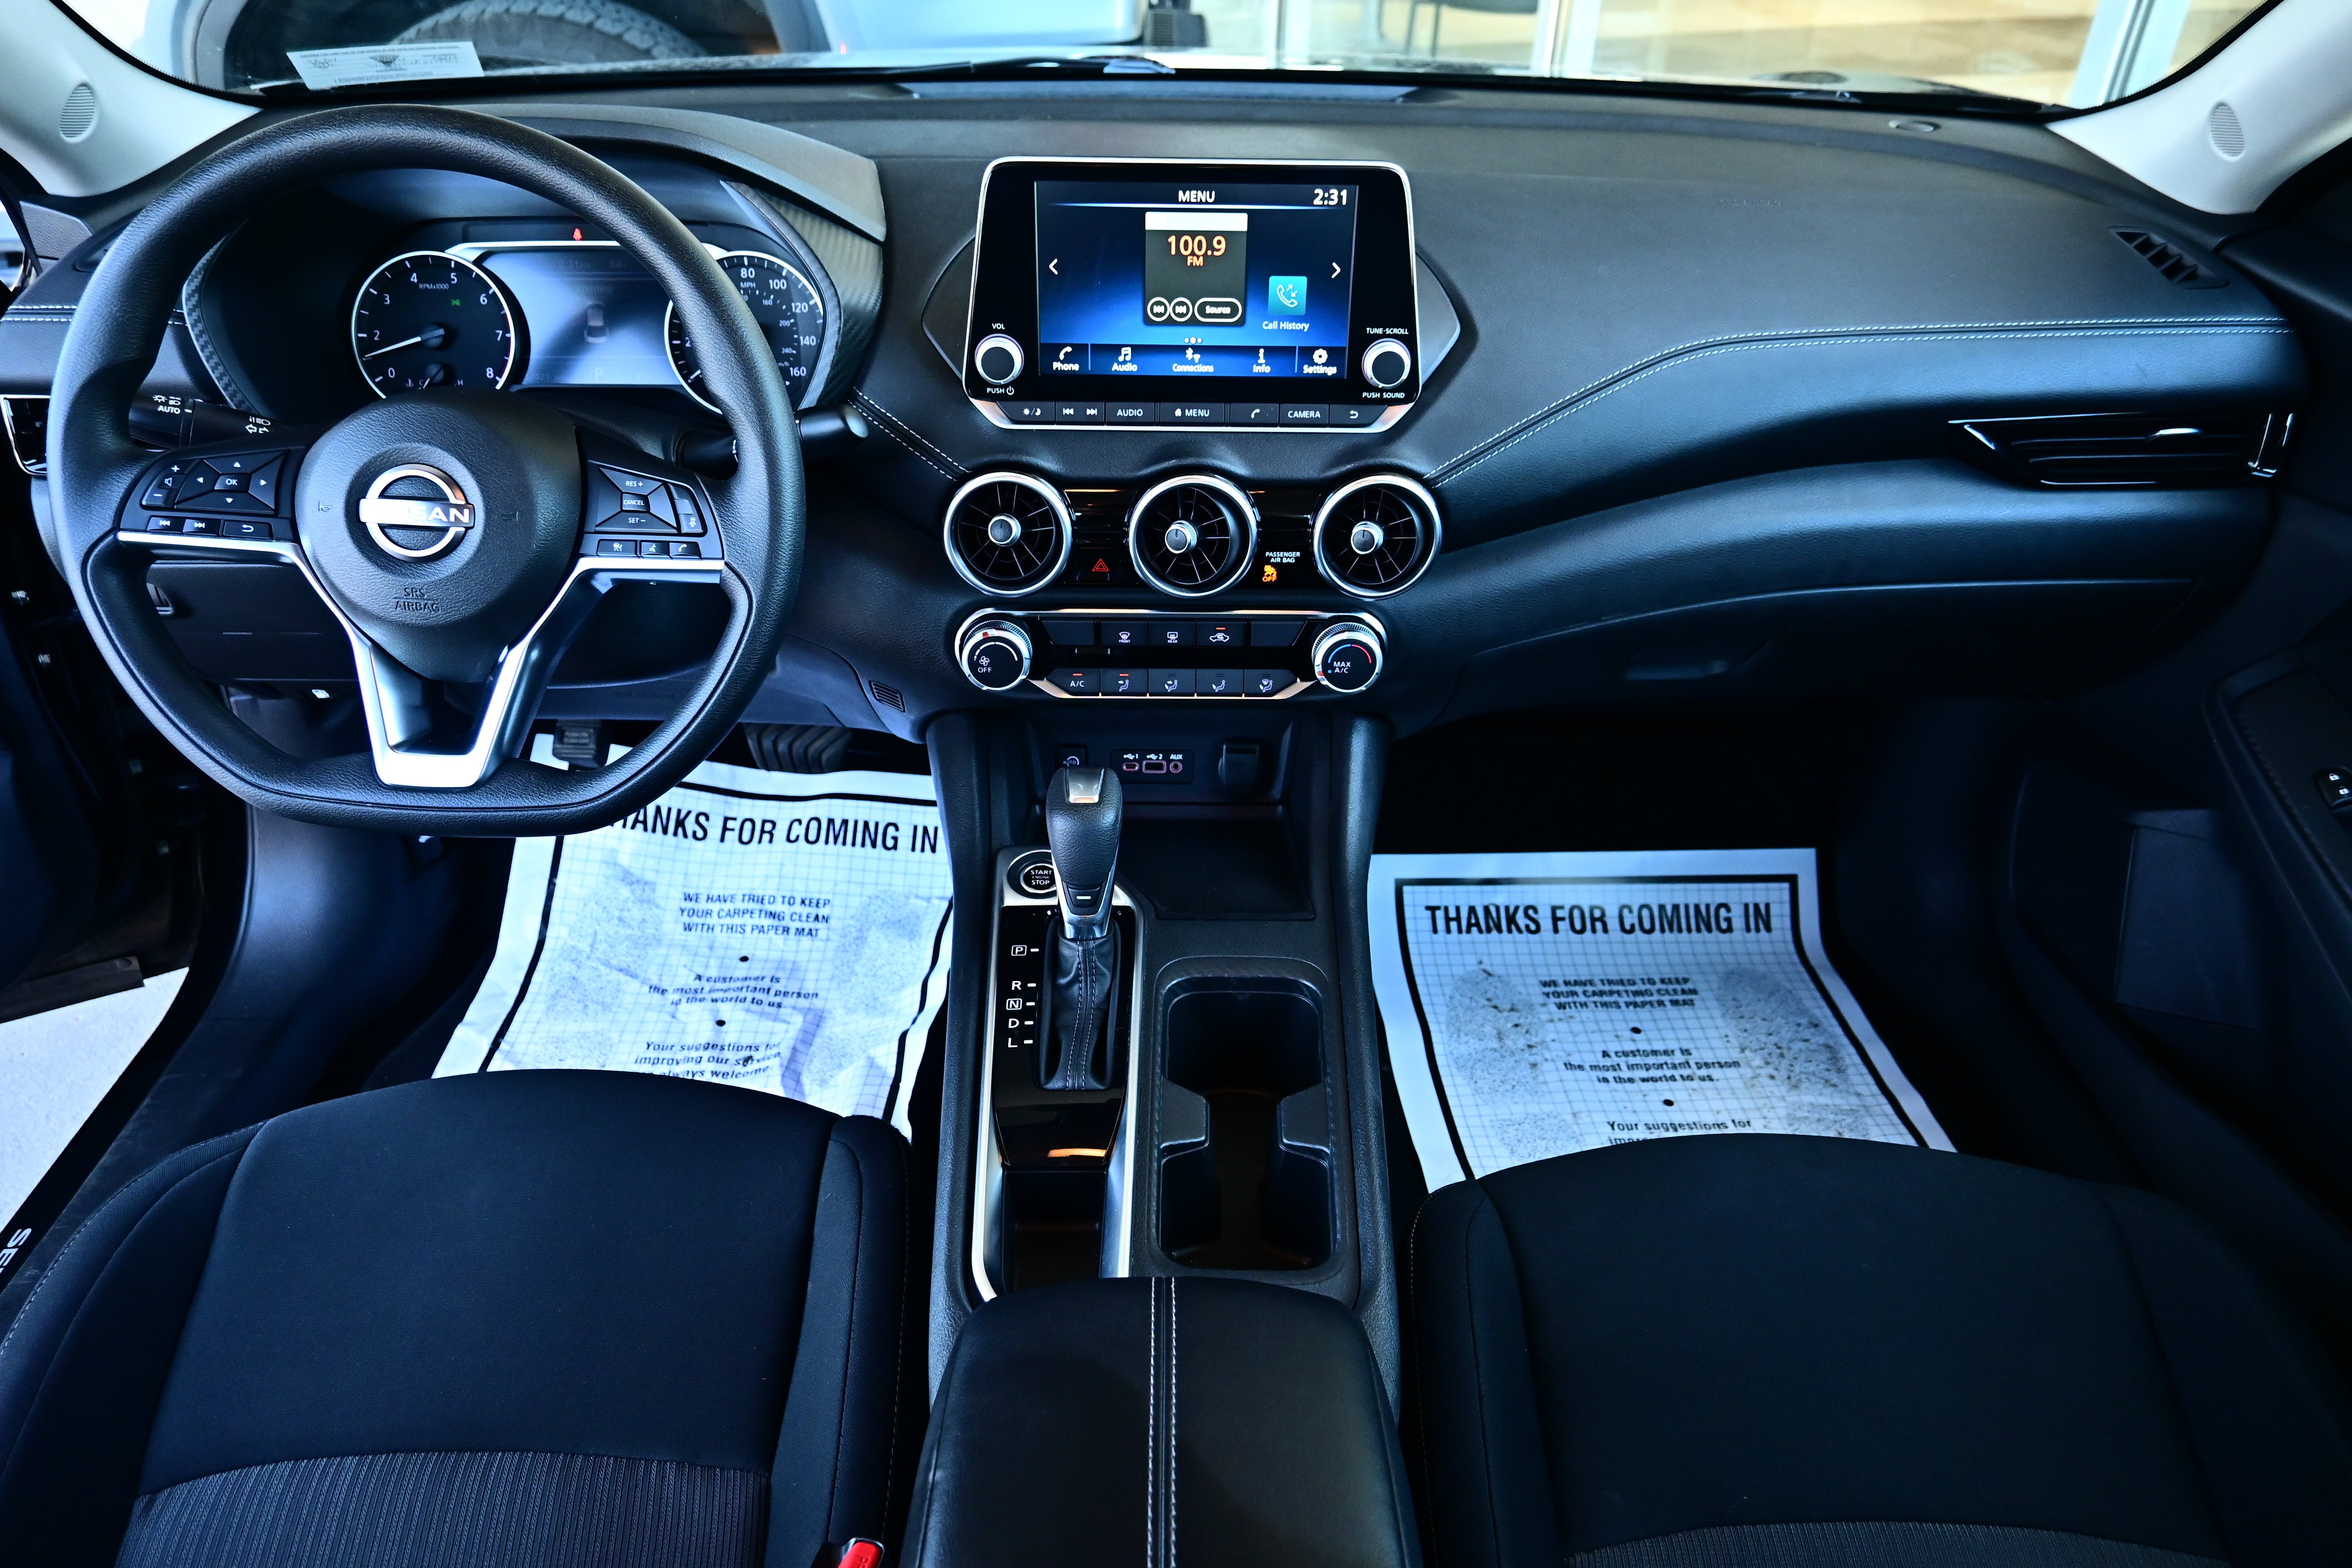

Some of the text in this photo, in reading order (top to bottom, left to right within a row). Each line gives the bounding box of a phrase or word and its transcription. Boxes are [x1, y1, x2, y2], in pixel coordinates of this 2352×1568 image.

[1178, 190, 1215, 203] MENU
[1312, 188, 1347, 205] 2:31
[1168, 235, 1226, 256] 100.9
[1187, 256, 1203, 267] FM
[410, 272, 418, 283] 4
[450, 272, 457, 284] 5
[740, 268, 755, 278] 80
[769, 279, 787, 289] 100
[383, 294, 390, 305] 3
[480, 294, 487, 305] 6
[791, 302, 808, 313] 120
[1205, 305, 1231, 314] Source
[1262, 321, 1310, 332] Call History
[373, 331, 380, 340] 2
[495, 331, 503, 340] 7
[799, 336, 816, 346] 140
[789, 367, 806, 377] 160
[1053, 362, 1079, 371] Phone
[1111, 362, 1138, 372] Audio
[1172, 363, 1214, 373] Connections
[1252, 364, 1271, 374] Info
[1303, 365, 1337, 376] Settings
[388, 368, 395, 378] 0
[486, 367, 493, 378] 8
[158, 406, 180, 414] AUTO
[1116, 408, 1143, 417] AUDIO
[1185, 408, 1210, 417] MENU
[1288, 410, 1320, 419] CAMERA
[404, 588, 426, 597] SRS
[395, 600, 440, 612] AIRBAG
[610, 805, 938, 853] ANKS FOR COMING IN
[683, 892, 830, 909] WE HAVE TRIED TO KEEP
[679, 907, 830, 924] YOUR CARPETING CLEAN
[1425, 903, 1773, 935] THANKS FOR COMING IN
[683, 922, 820, 937] WITH THIS PAPER MAT
[693, 975, 702, 983] A
[770, 975, 781, 984] is
[1012, 980, 1021, 990] R
[1640, 977, 1656, 985] TO
[648, 985, 667, 995] the
[774, 989, 819, 999] person
[711, 995, 746, 1004] world
[751, 997, 763, 1006] to
[1009, 1000, 1018, 1008] N
[1008, 1018, 1019, 1028] D
[646, 1042, 675, 1051] Your
[679, 1042, 760, 1052] suggestions
[1008, 1037, 1018, 1048] L
[1602, 1048, 1692, 1059] A customer is
[634, 1055, 702, 1067] improving
[708, 1056, 730, 1065] our
[1564, 1060, 1741, 1072] the most important person
[1597, 1075, 1610, 1084] in
[1613, 1075, 1636, 1084] the
[1639, 1073, 1677, 1083] world
[1680, 1073, 1694, 1082] to
[1607, 1119, 1752, 1132] Your suggestions for
[0, 1228, 32, 1274] SE
